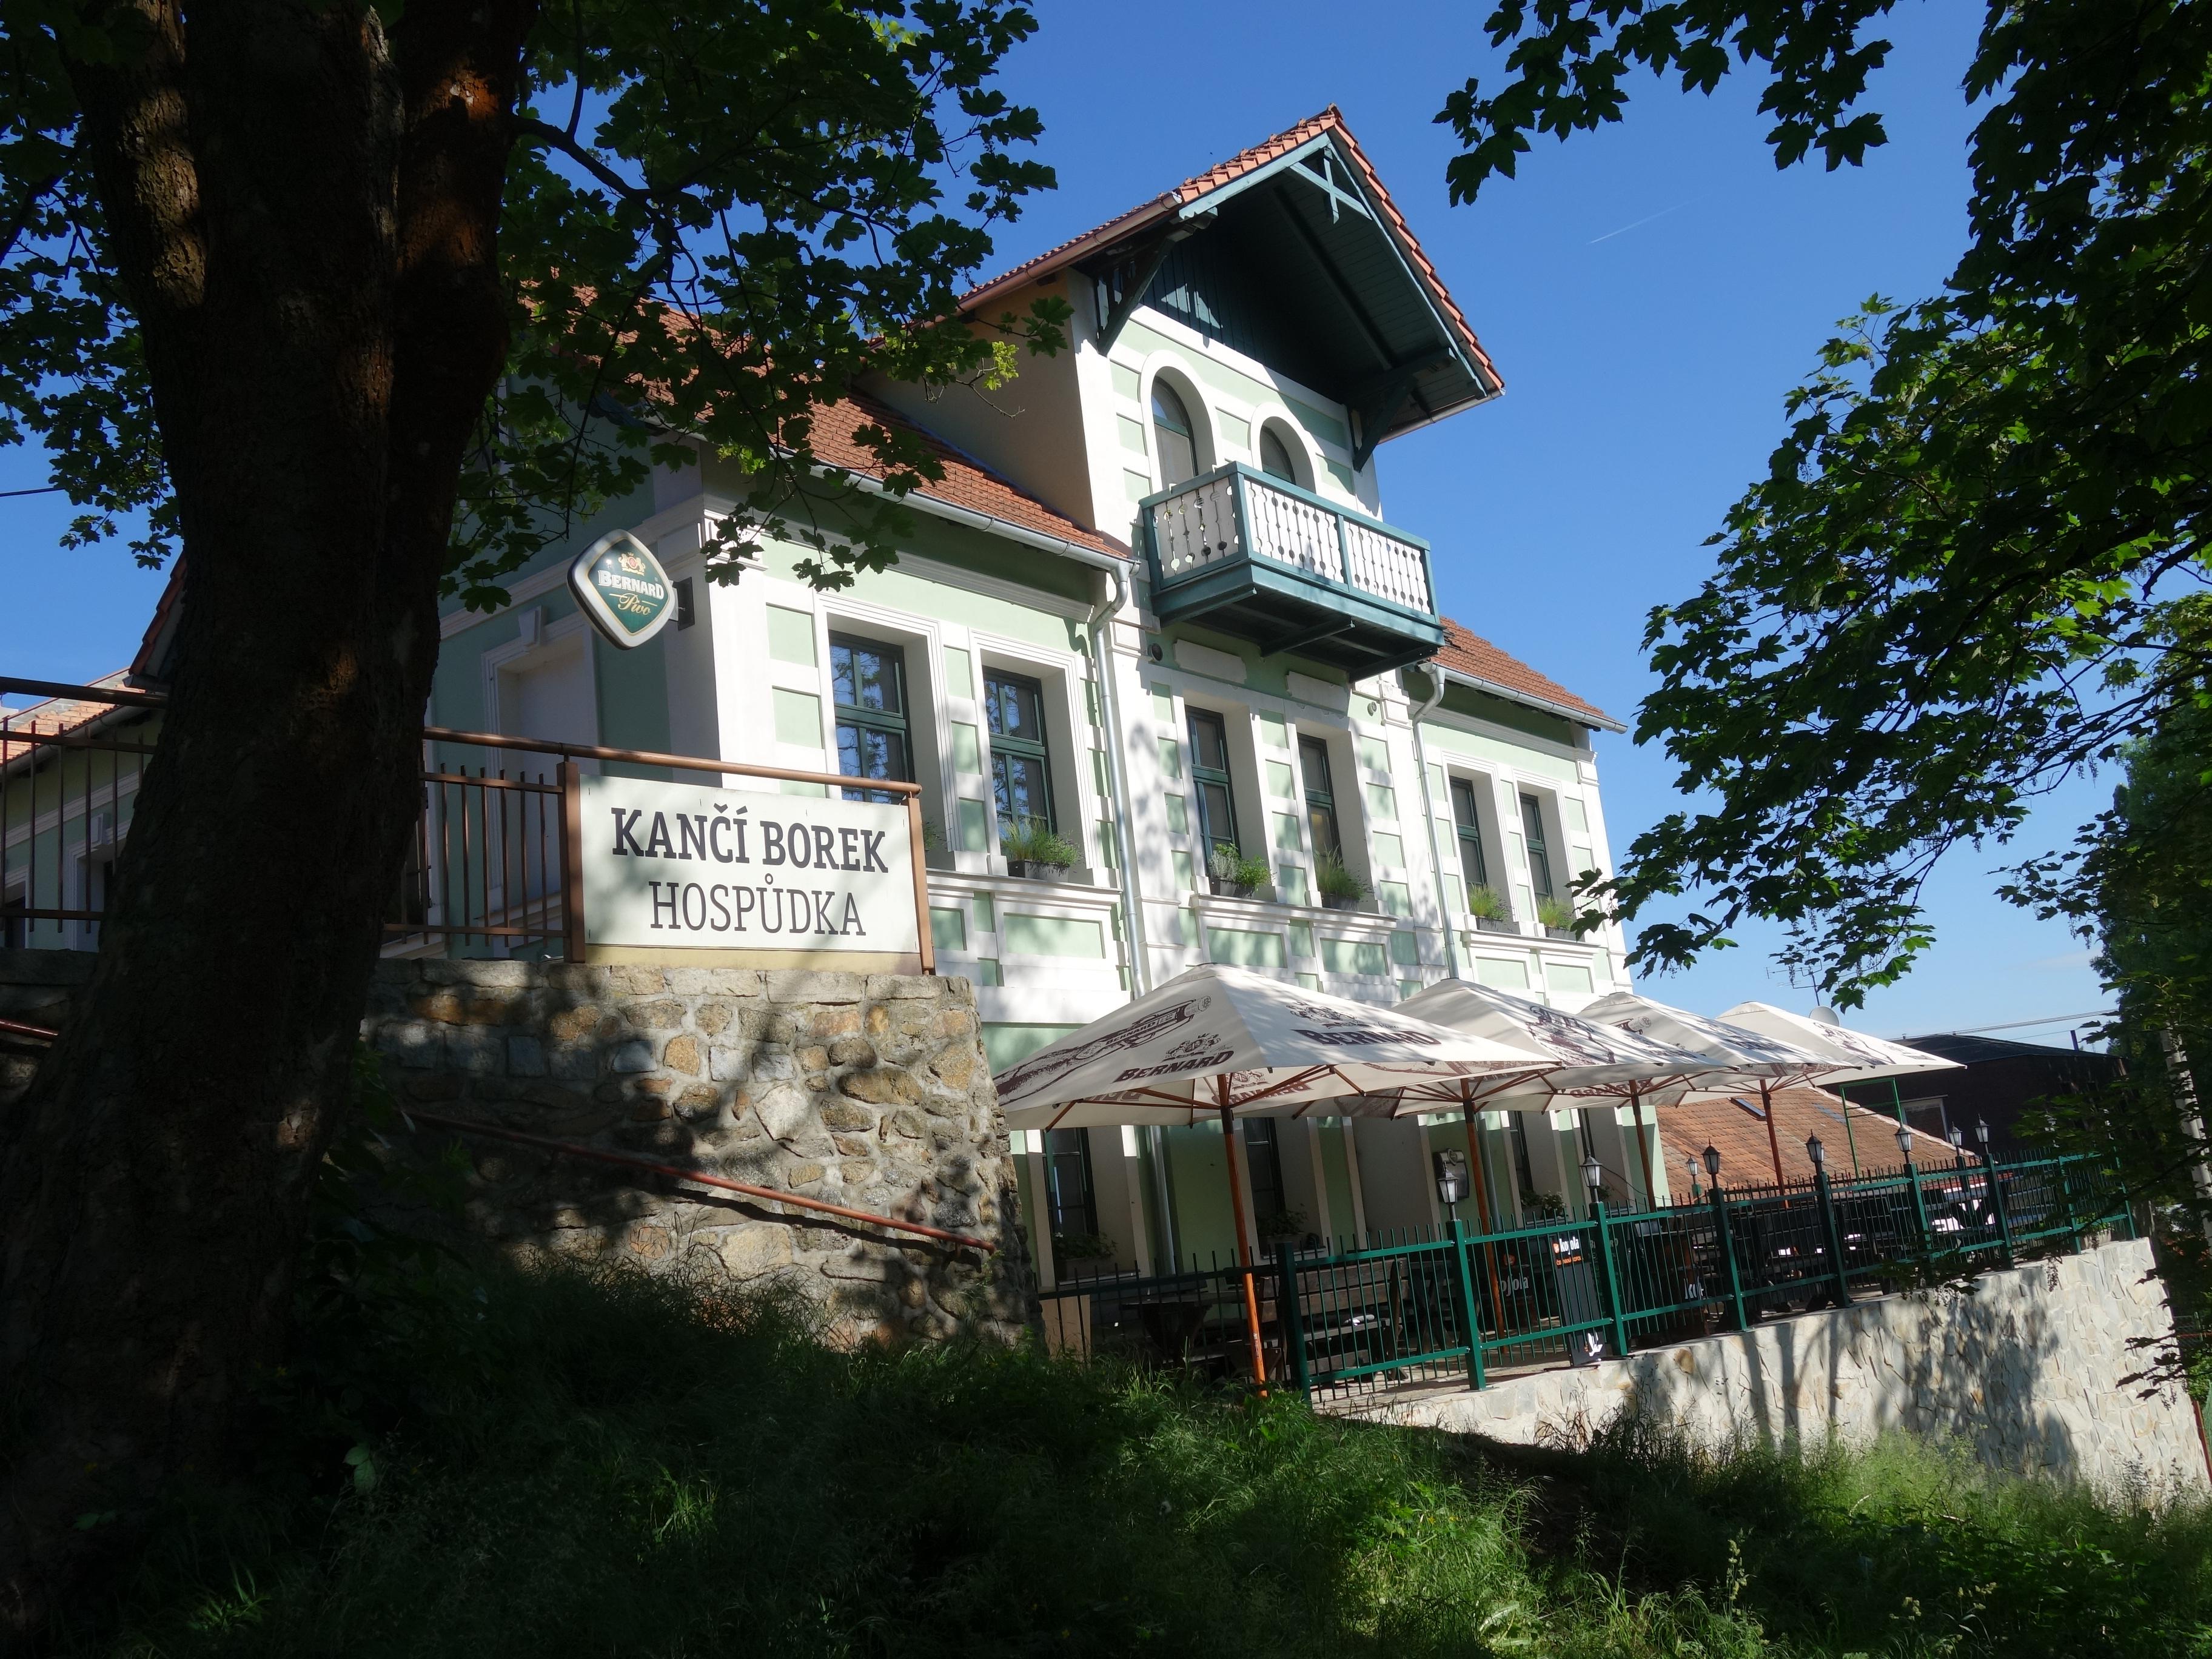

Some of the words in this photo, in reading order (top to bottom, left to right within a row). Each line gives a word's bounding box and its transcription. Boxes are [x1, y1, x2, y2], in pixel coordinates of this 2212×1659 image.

[598, 570, 665, 600] BERNARD
[618, 593, 651, 615] Pivo
[611, 803, 750, 864] KANČÍ
[760, 820, 889, 873] BOREK
[648, 873, 866, 936] HOSPŮDKA
[1290, 1029, 1442, 1046] BERNARD
[1112, 1050, 1235, 1084] BERNARD
